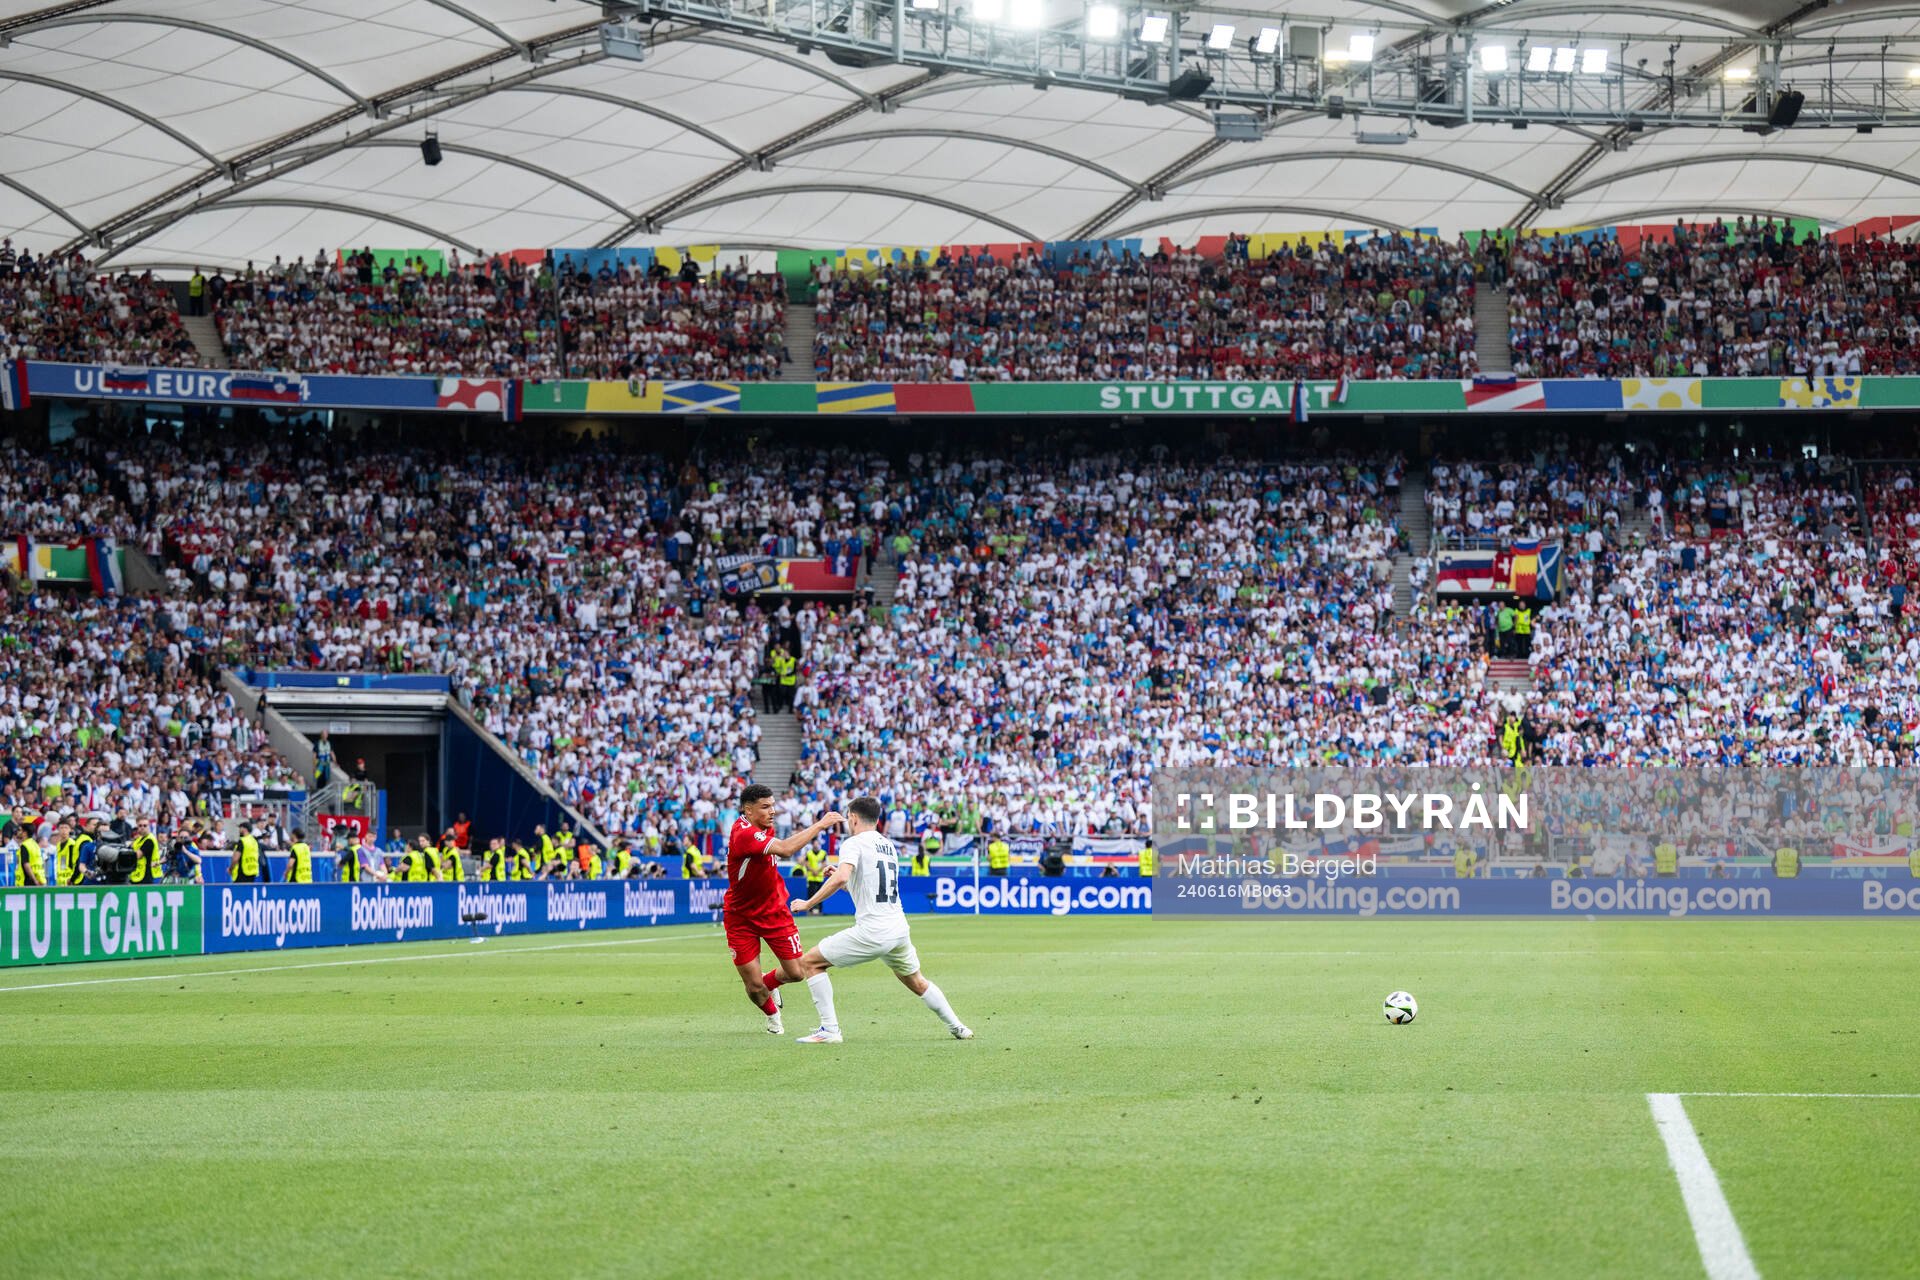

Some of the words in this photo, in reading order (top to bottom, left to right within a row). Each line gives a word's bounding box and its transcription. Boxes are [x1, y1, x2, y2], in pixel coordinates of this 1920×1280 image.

[624, 881, 675, 924] Booking.com
[876, 860, 897, 904] 13
[936, 878, 1152, 916] Booking.com
[1241, 879, 1460, 916] Booking.com
[1550, 879, 1771, 916] Booking.com
[0, 891, 184, 960] TUTTGART
[222, 886, 321, 947] Booking.com
[351, 884, 433, 941] Booking.com
[458, 883, 527, 934] Booking.com
[547, 882, 607, 929] Booking.com
